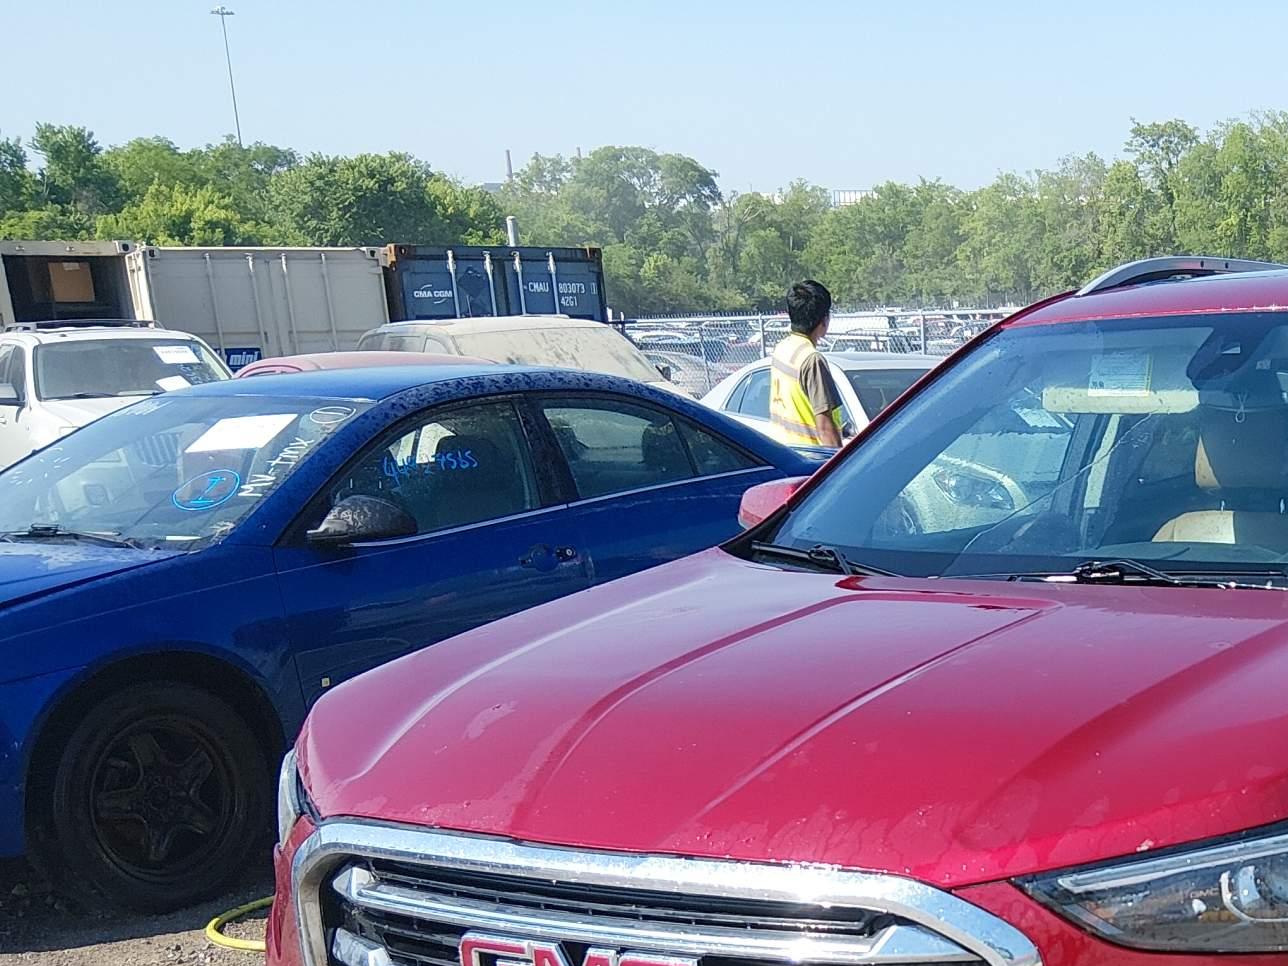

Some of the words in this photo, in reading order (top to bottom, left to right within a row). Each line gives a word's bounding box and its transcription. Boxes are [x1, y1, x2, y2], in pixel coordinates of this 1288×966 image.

[413, 290, 433, 298] CMA
[433, 290, 453, 298] CGM
[528, 282, 549, 293] CMAU
[558, 283, 585, 294] 803073
[229, 351, 259, 366] mini
